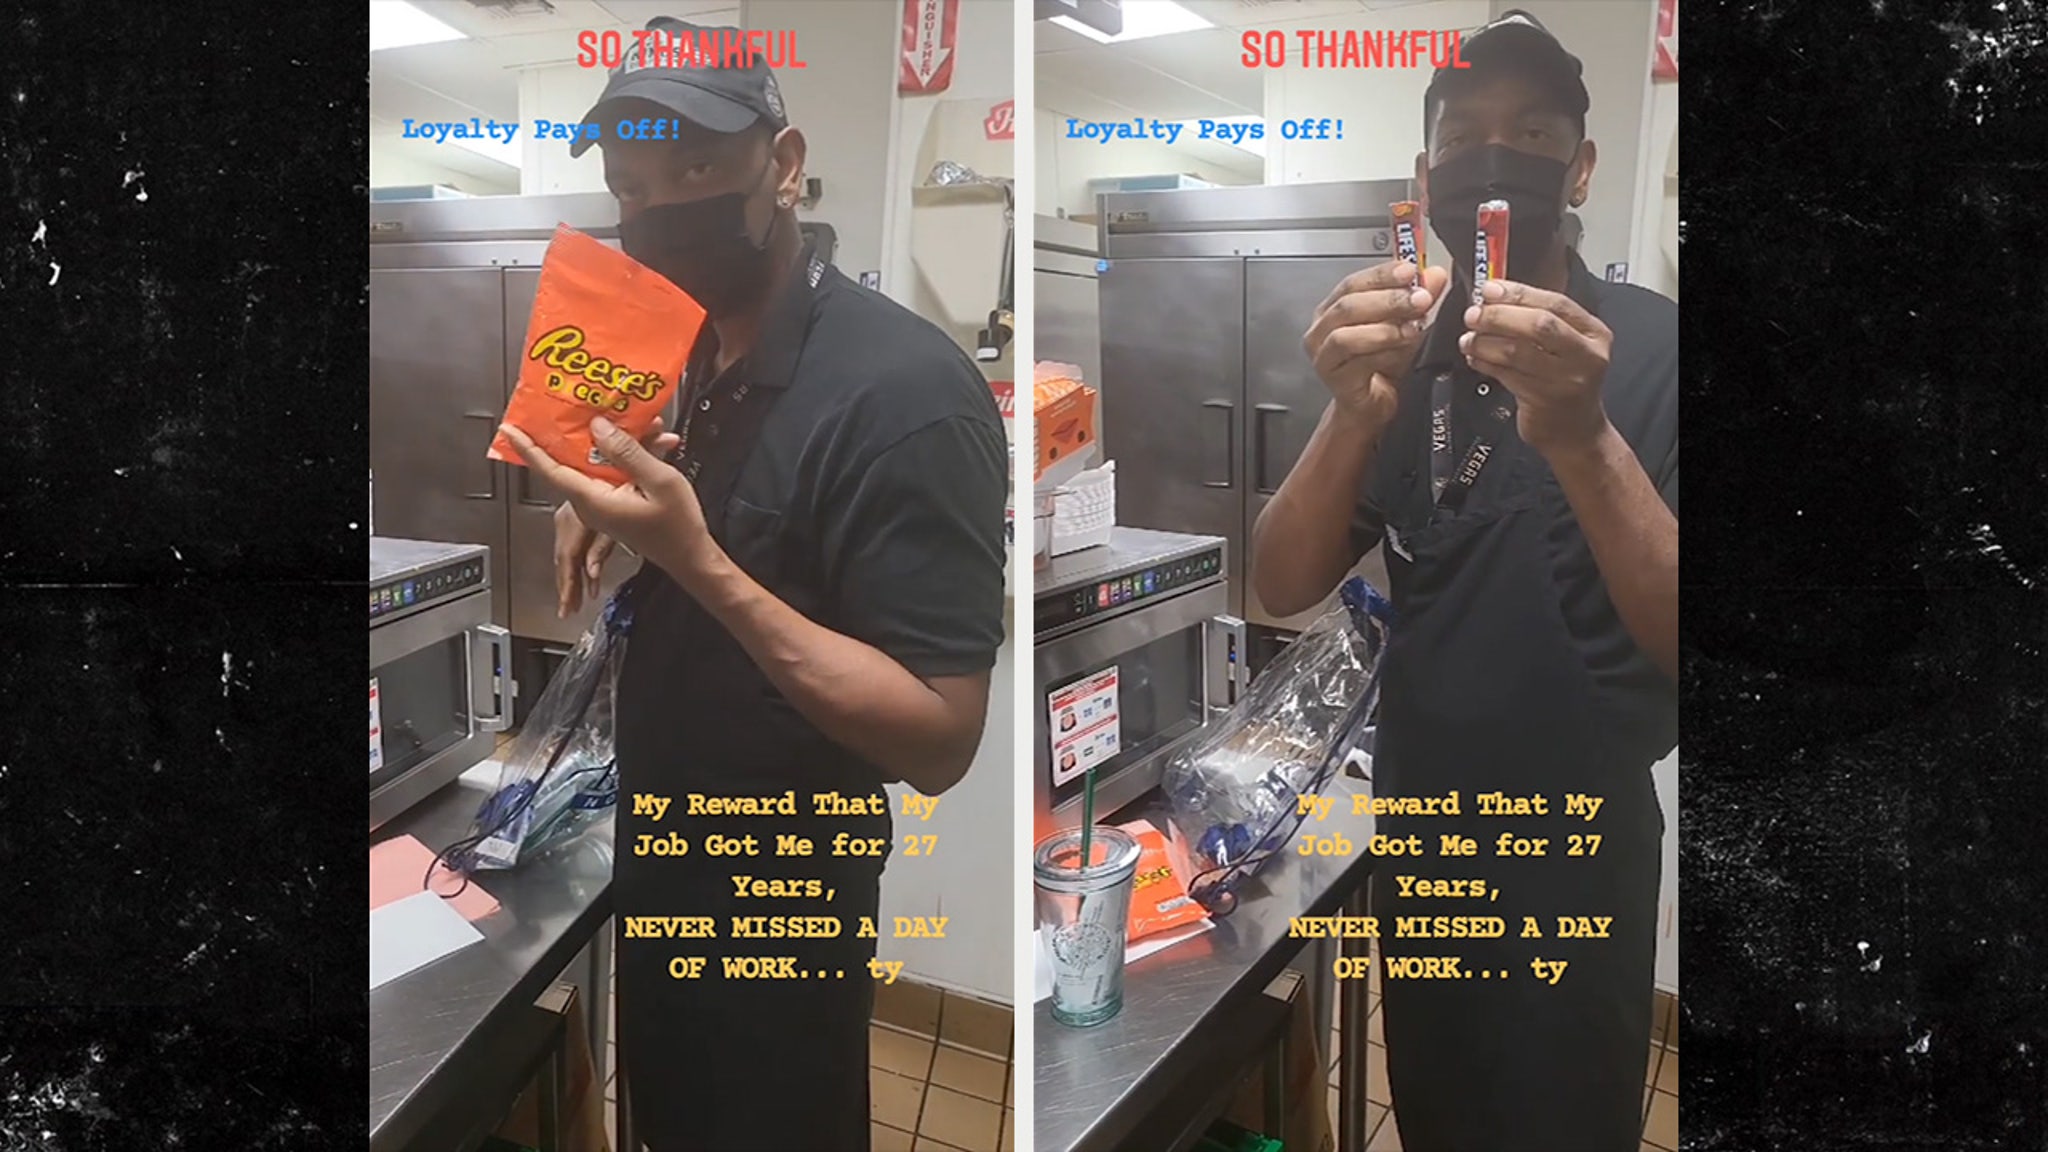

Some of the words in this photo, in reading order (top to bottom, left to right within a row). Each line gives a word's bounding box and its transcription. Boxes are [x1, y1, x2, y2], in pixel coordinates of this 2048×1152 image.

[920, 0, 937, 76] NGUISHER
[529, 324, 665, 400] Reese's
[1432, 409, 1446, 451] VEGAS
[1459, 443, 1492, 486] VEGAS
